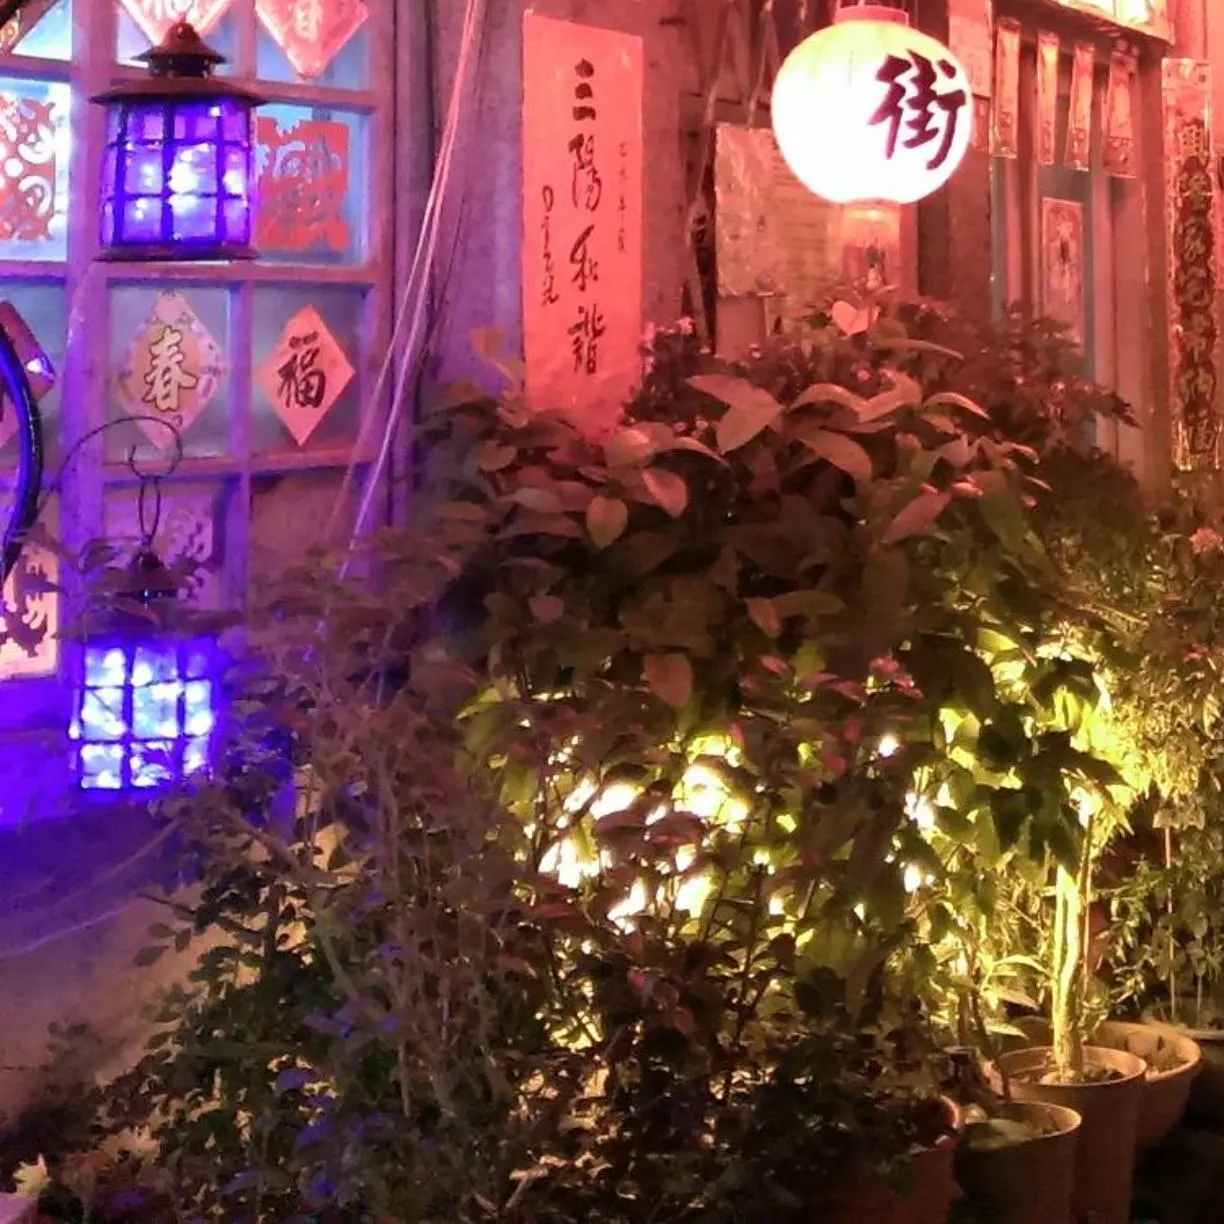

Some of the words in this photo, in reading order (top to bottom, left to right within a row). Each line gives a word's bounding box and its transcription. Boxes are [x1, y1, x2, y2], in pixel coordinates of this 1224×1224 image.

[867, 48, 967, 171] 街
[142, 324, 198, 413] 春
[276, 330, 327, 409] 福
